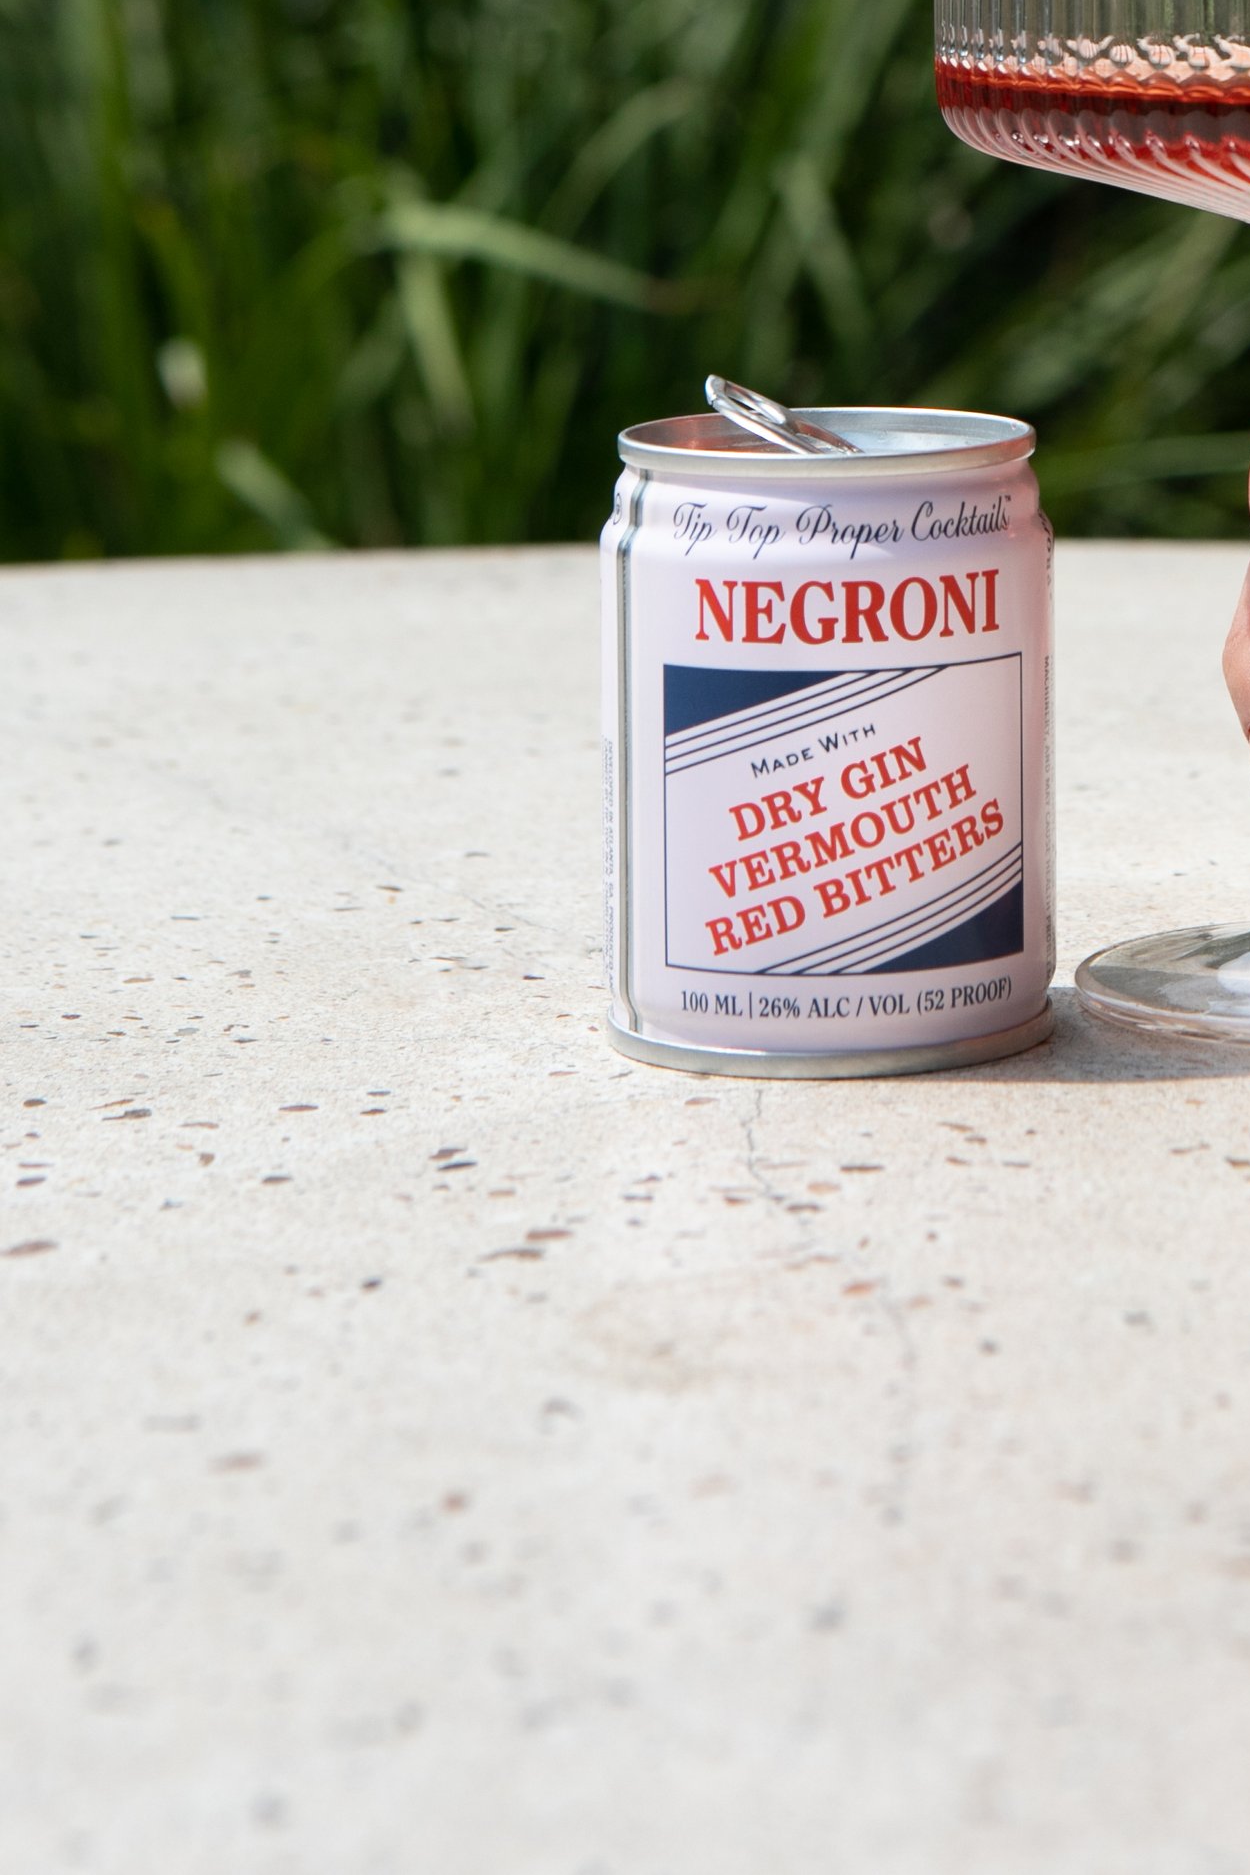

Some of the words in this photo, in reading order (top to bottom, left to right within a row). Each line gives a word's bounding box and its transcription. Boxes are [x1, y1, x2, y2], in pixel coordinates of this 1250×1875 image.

[673, 502, 716, 556] Tip
[726, 505, 786, 560] Top
[796, 503, 905, 560] Proper
[695, 568, 999, 645] NEGRONI
[729, 776, 827, 841] DRY
[840, 736, 927, 800] GIN
[751, 754, 813, 778] MADE
[818, 724, 876, 753] WITH
[708, 764, 977, 898] VERMOUTH
[705, 895, 806, 956] RED
[813, 799, 1004, 918] BITTERS
[681, 991, 709, 1013] 100
[714, 994, 743, 1017] ML
[758, 997, 801, 1018] 26%
[806, 996, 850, 1018] ALC
[868, 993, 910, 1017] VOL
[916, 989, 945, 1015] (52
[950, 975, 1013, 1008] PROOF)
